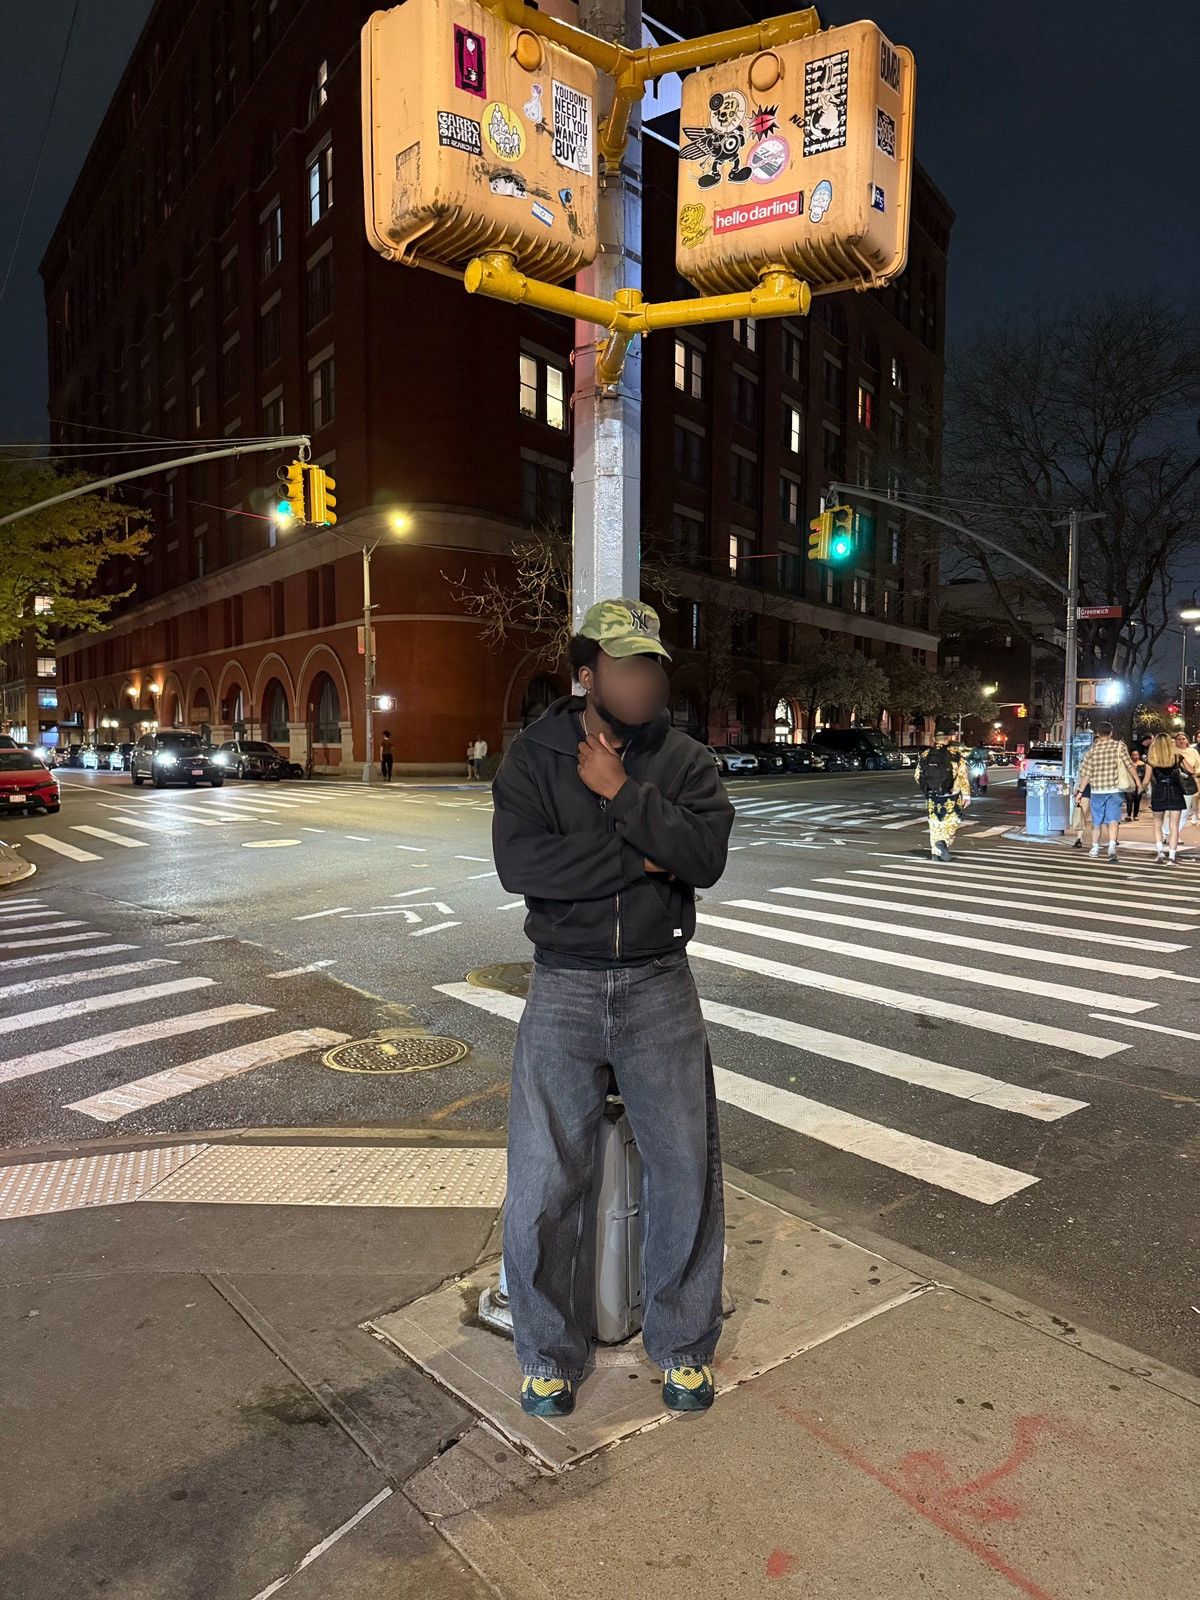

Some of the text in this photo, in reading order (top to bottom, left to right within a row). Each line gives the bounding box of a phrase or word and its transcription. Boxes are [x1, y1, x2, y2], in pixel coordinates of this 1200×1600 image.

[555, 84, 587, 108] YOU DONT
[723, 101, 734, 110] 21
[555, 96, 587, 123] NEED IT
[438, 112, 480, 134] GARBO
[555, 111, 588, 136] BUT YOU
[555, 124, 579, 145] WANT
[555, 139, 576, 163] BUY
[715, 212, 748, 229] hello
[749, 199, 798, 221] darling
[1080, 608, 1109, 616] Greenwich
